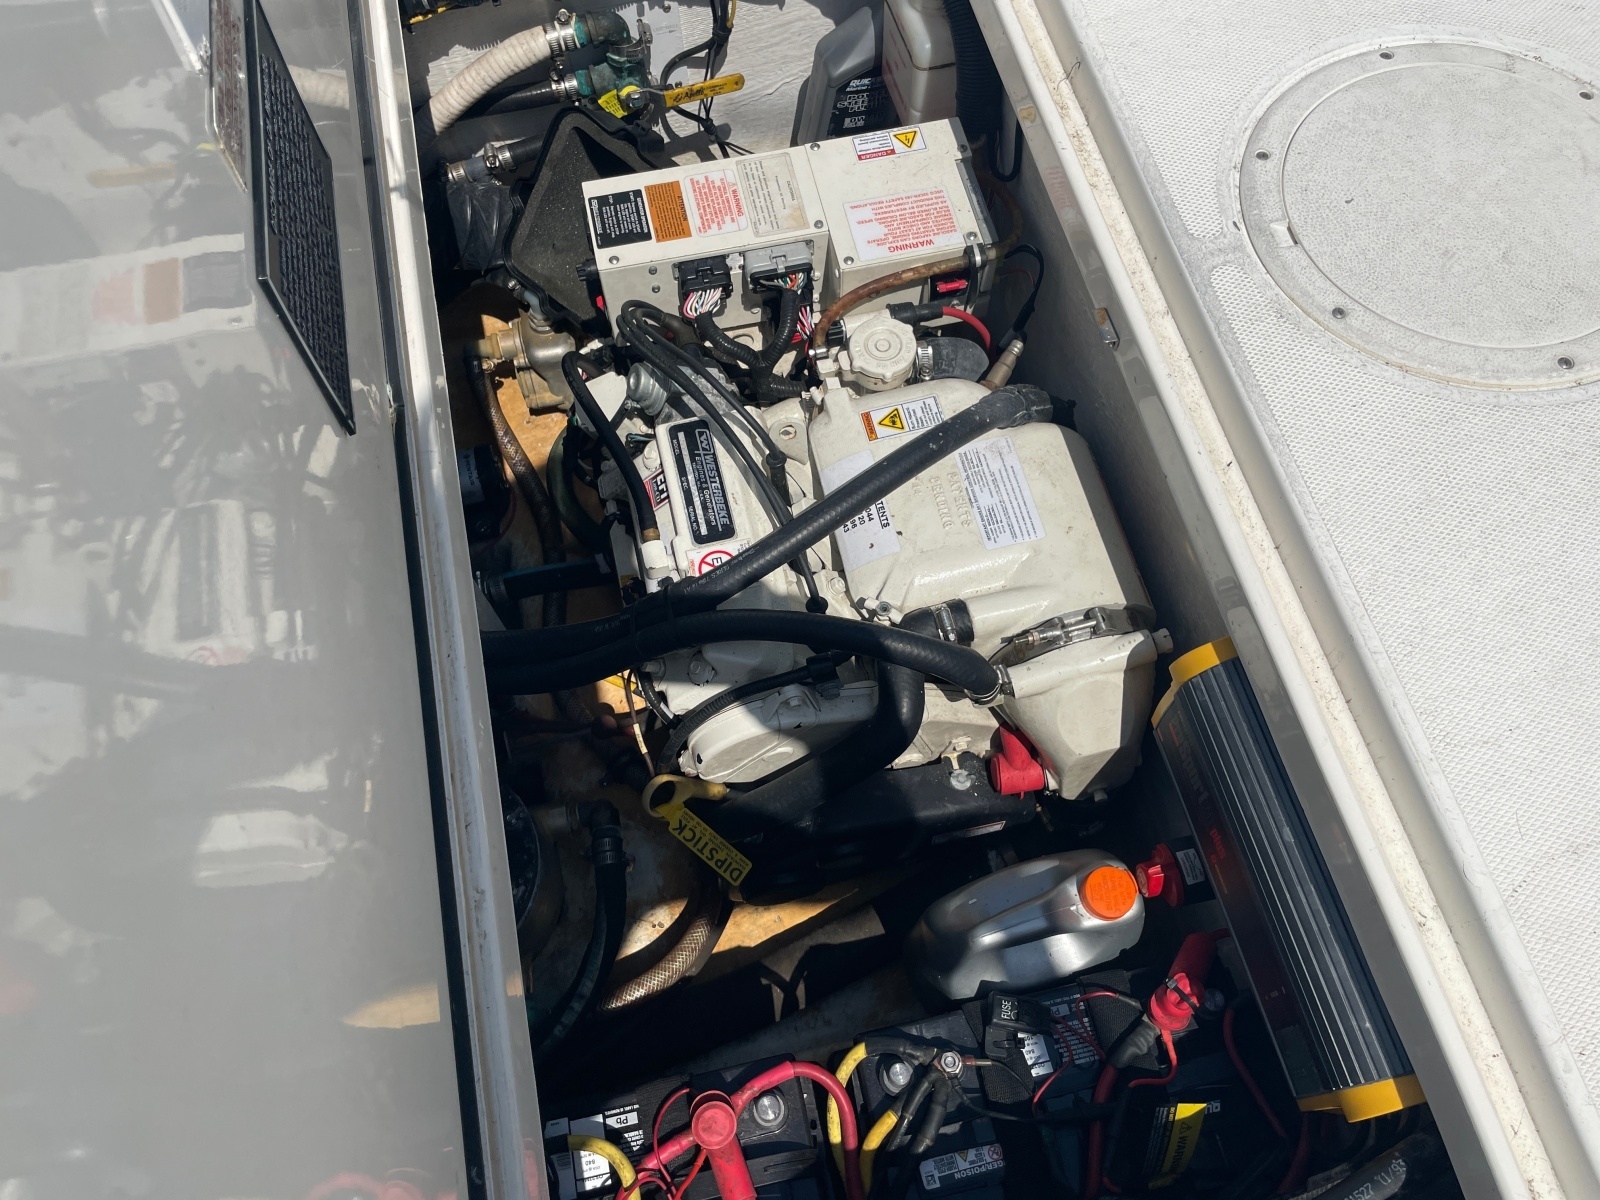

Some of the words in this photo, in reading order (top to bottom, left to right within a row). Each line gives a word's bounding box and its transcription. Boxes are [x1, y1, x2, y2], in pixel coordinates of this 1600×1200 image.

[849, 78, 871, 87] QUIC
[836, 99, 868, 107] STEE
[860, 151, 886, 159] DANGER
[677, 195, 687, 221] ATTENTION
[731, 188, 743, 216] WARNING
[887, 238, 934, 252] WARNING
[694, 456, 705, 482] Engines
[702, 489, 717, 525] Generators
[703, 454, 730, 525] WESTERBEKE
[930, 475, 953, 530] PENDING
[948, 470, 971, 529] PATENTS
[849, 518, 858, 529] 96
[864, 507, 874, 522] 044
[876, 500, 890, 529] TENTS
[670, 817, 743, 882] DIPSTICK
[999, 999, 1013, 1019] FUSE
[614, 1115, 628, 1126] Pb
[952, 1160, 1005, 1178] GER/POISON
[1345, 1182, 1375, 1200] 1527
